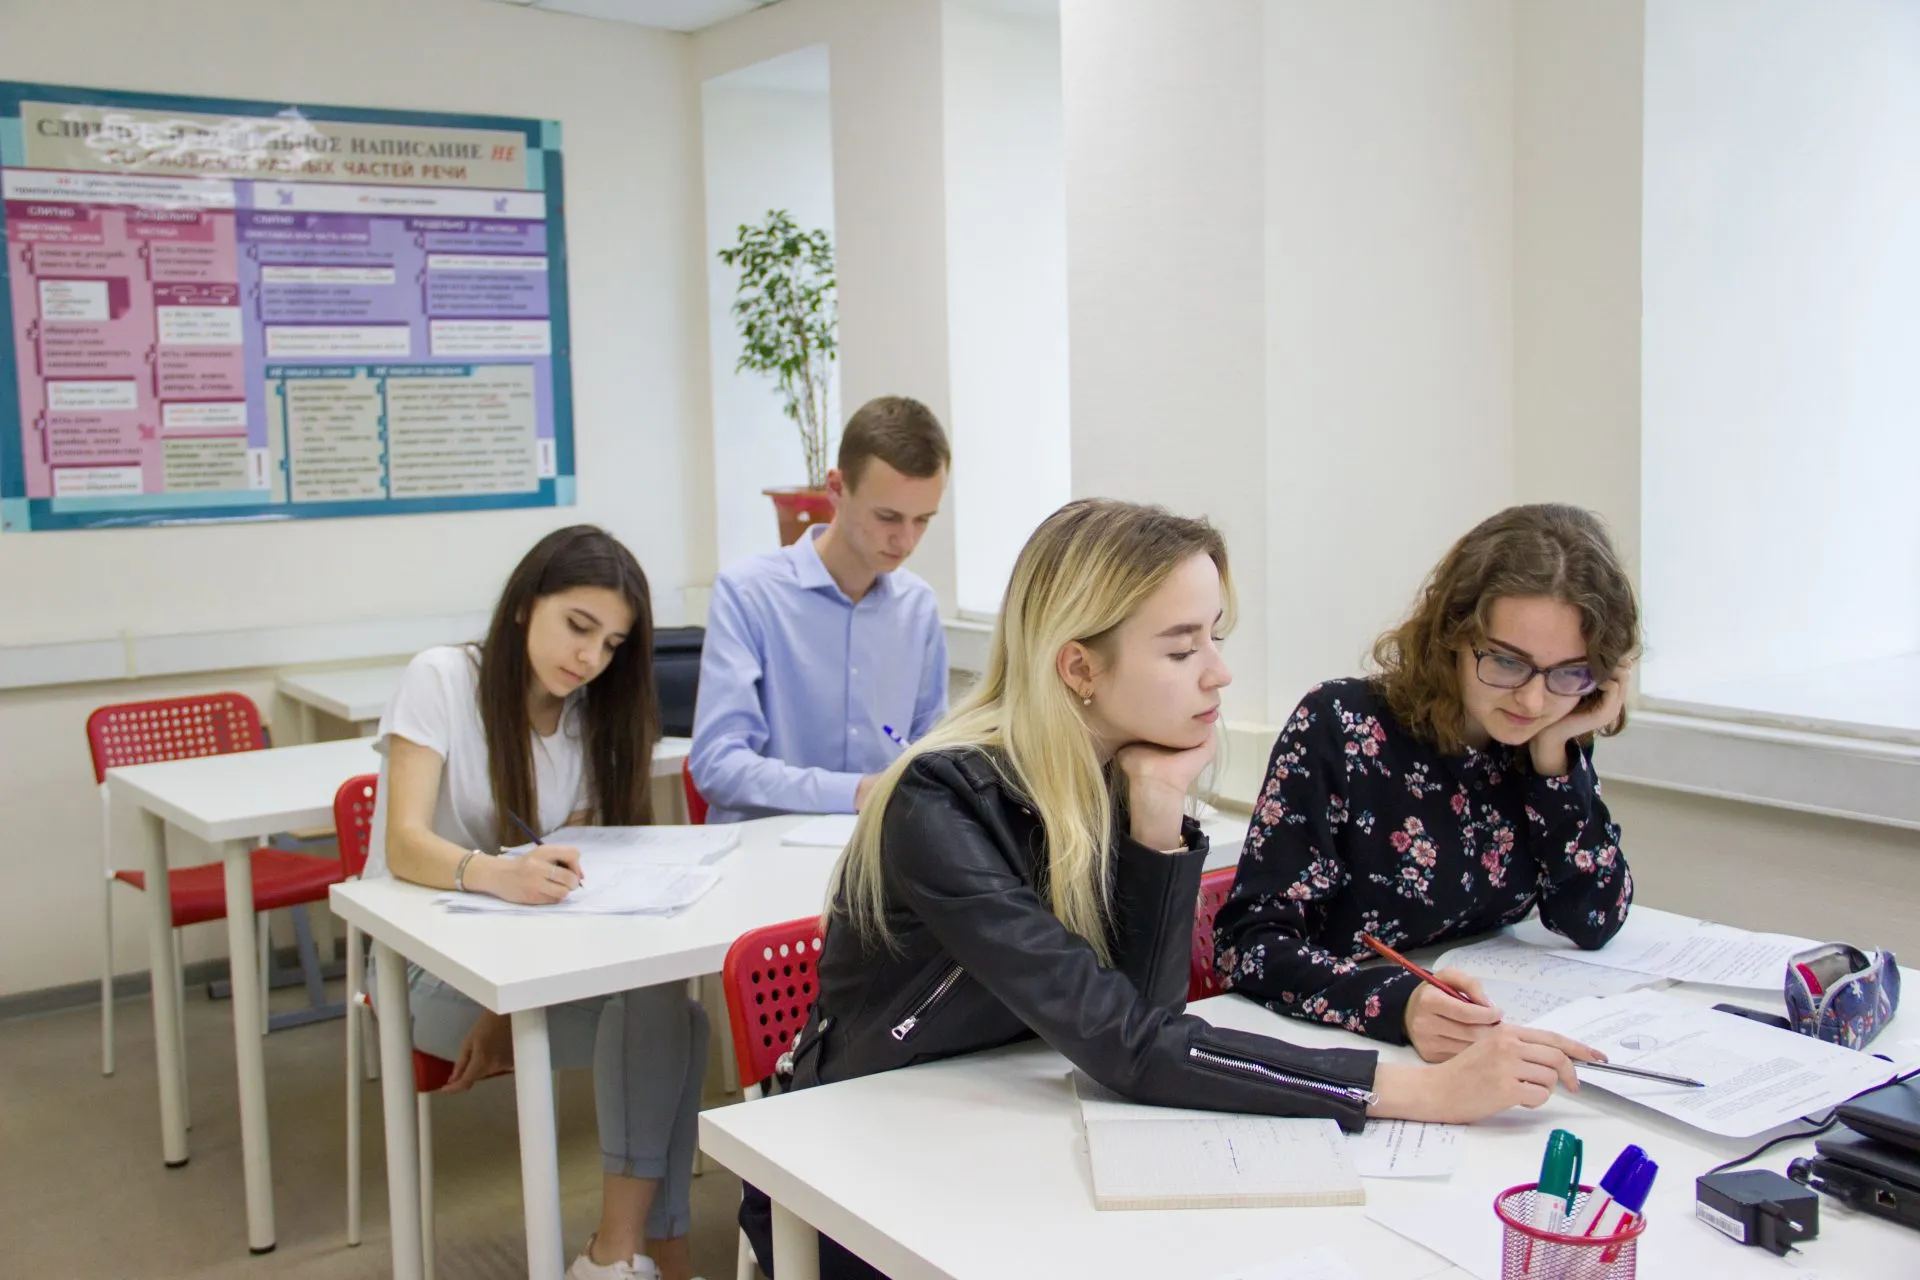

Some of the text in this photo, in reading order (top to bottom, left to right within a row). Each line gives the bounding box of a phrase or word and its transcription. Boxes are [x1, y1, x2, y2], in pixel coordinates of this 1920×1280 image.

[351, 136, 482, 160] НАПИСАНИЕ
[490, 145, 516, 161] НЕ
[342, 158, 414, 178] ЧАСТЕЙ
[421, 164, 467, 180] РЕЧИ
